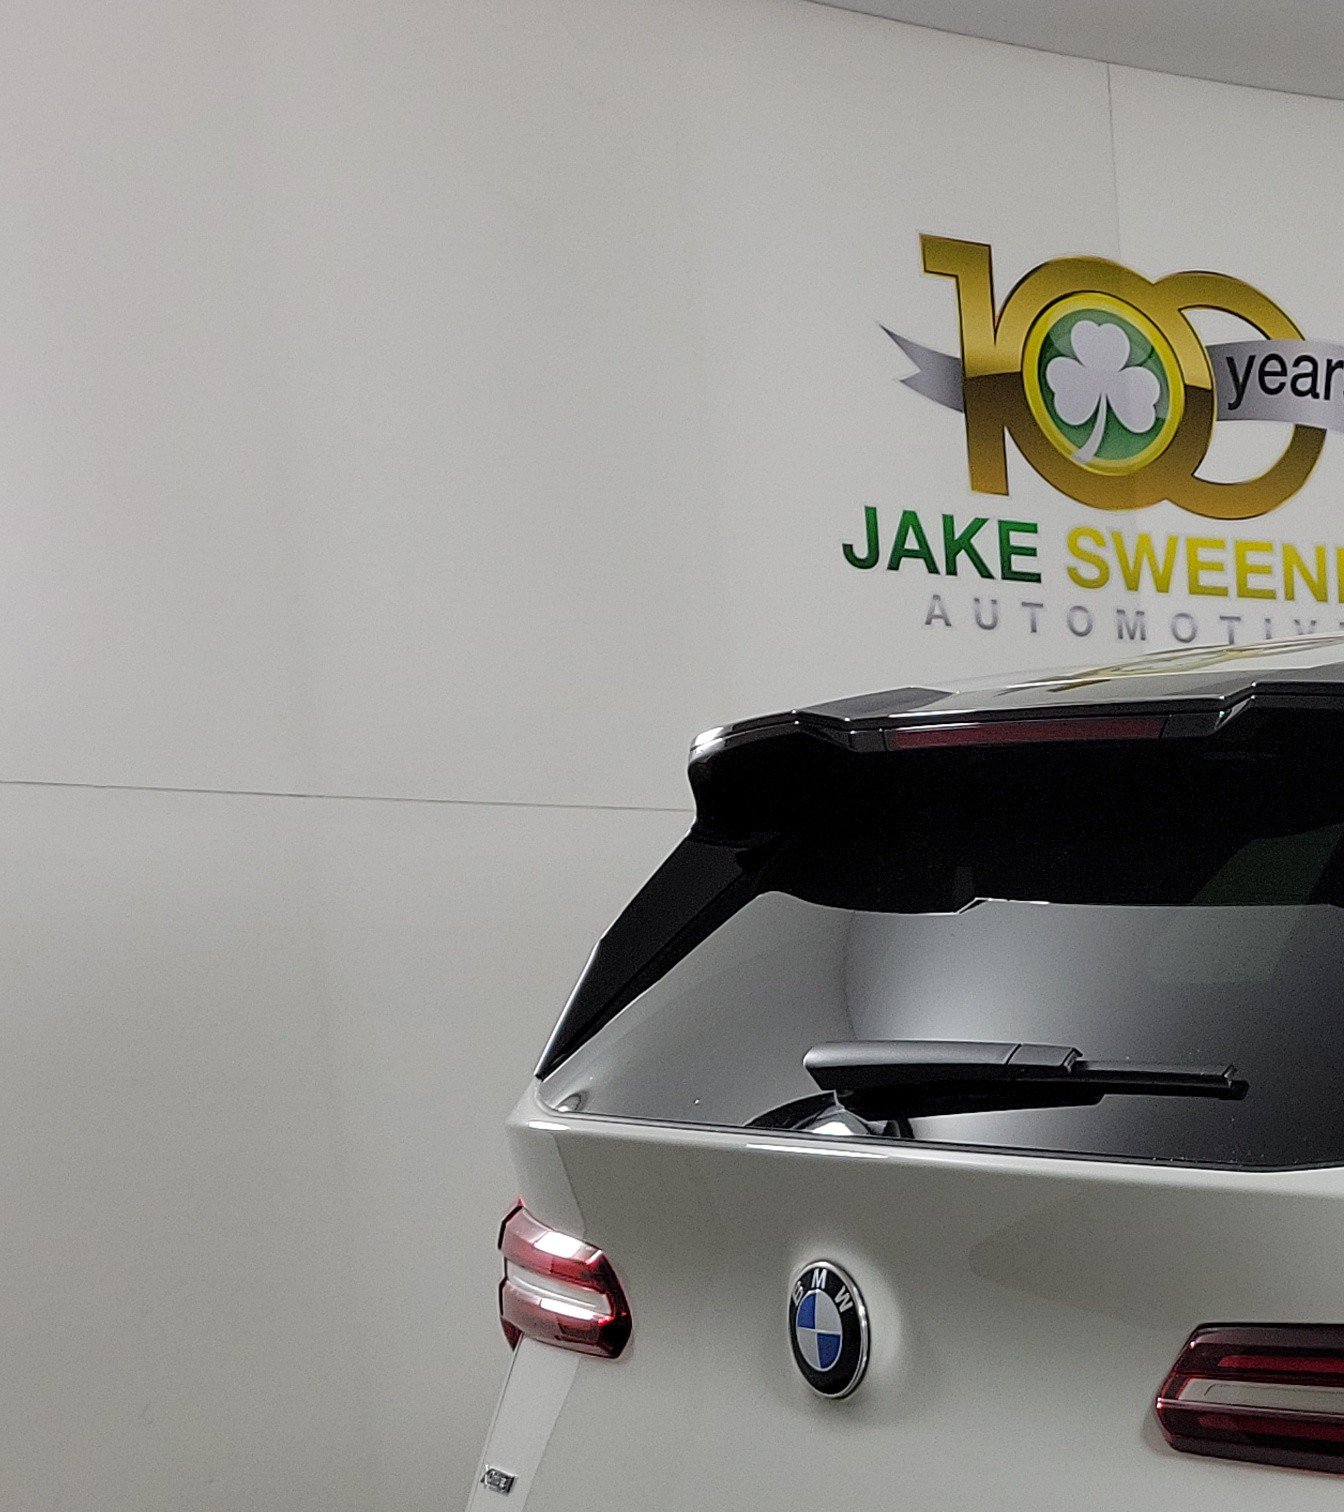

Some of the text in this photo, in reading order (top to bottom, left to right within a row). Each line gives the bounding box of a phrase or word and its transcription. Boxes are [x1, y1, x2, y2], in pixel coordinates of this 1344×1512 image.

[919, 233, 1327, 520] 100
[842, 505, 1043, 583] JAKE
[791, 1268, 854, 1313] BMW
